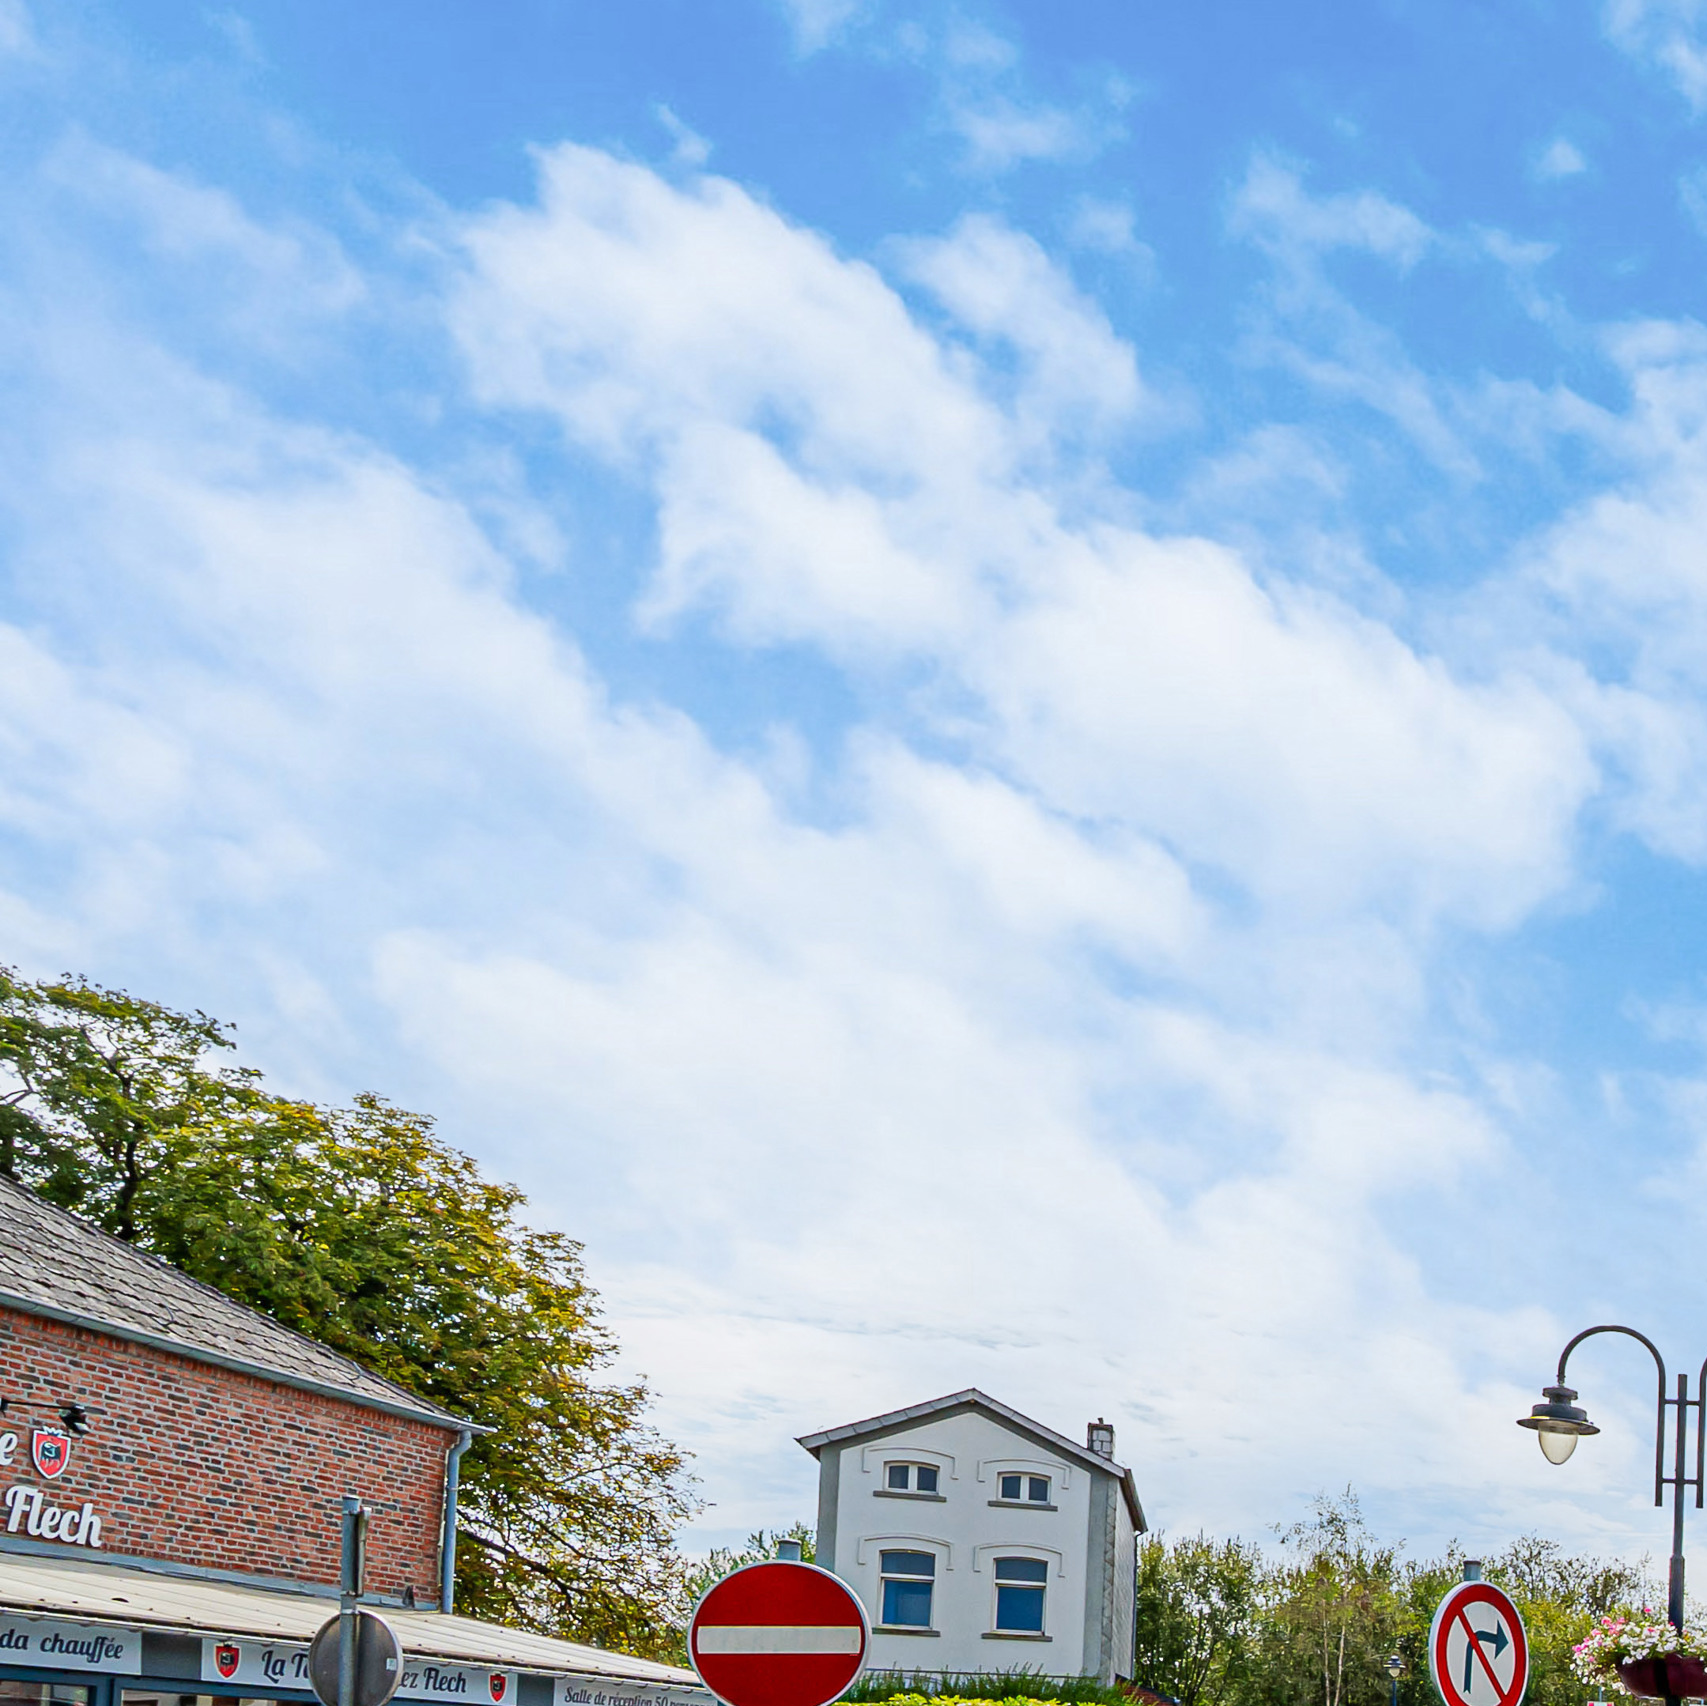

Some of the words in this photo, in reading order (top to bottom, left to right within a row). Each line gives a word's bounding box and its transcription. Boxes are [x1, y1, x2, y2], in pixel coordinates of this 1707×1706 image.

[5, 1485, 103, 1548] Flech
[40, 1632, 124, 1663] chauffée
[261, 1650, 286, 1684] La
[423, 1667, 466, 1693] Flech
[564, 1686, 592, 1705] Salle
[594, 1691, 605, 1706] de
